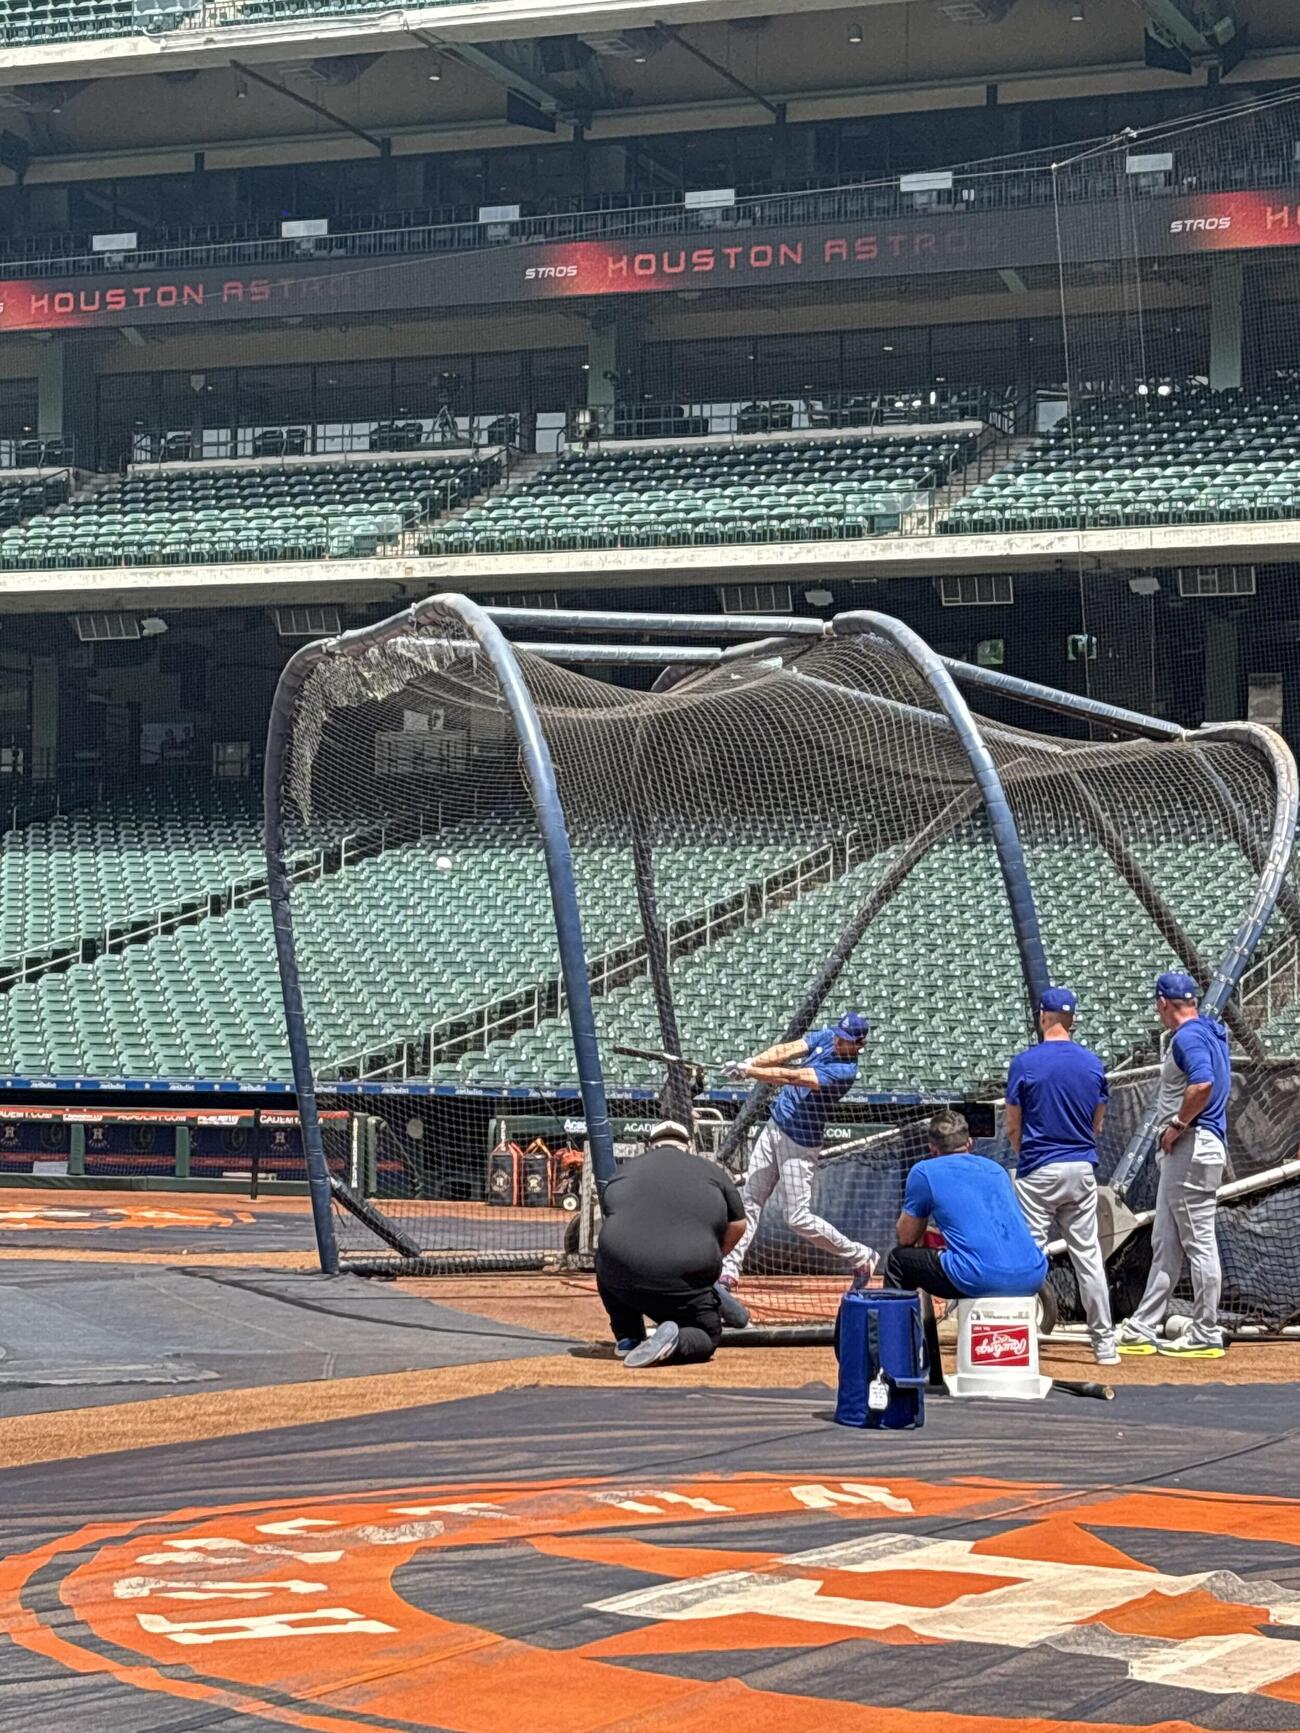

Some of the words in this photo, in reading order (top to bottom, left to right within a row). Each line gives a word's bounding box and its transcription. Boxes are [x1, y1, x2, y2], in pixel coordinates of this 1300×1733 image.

[1169, 216, 1231, 233] STROS
[607, 242, 802, 278] HOUSTON
[524, 264, 578, 280] STROS
[30, 283, 204, 315] HOUSTON
[975, 1335, 1027, 1358] Rawlings
